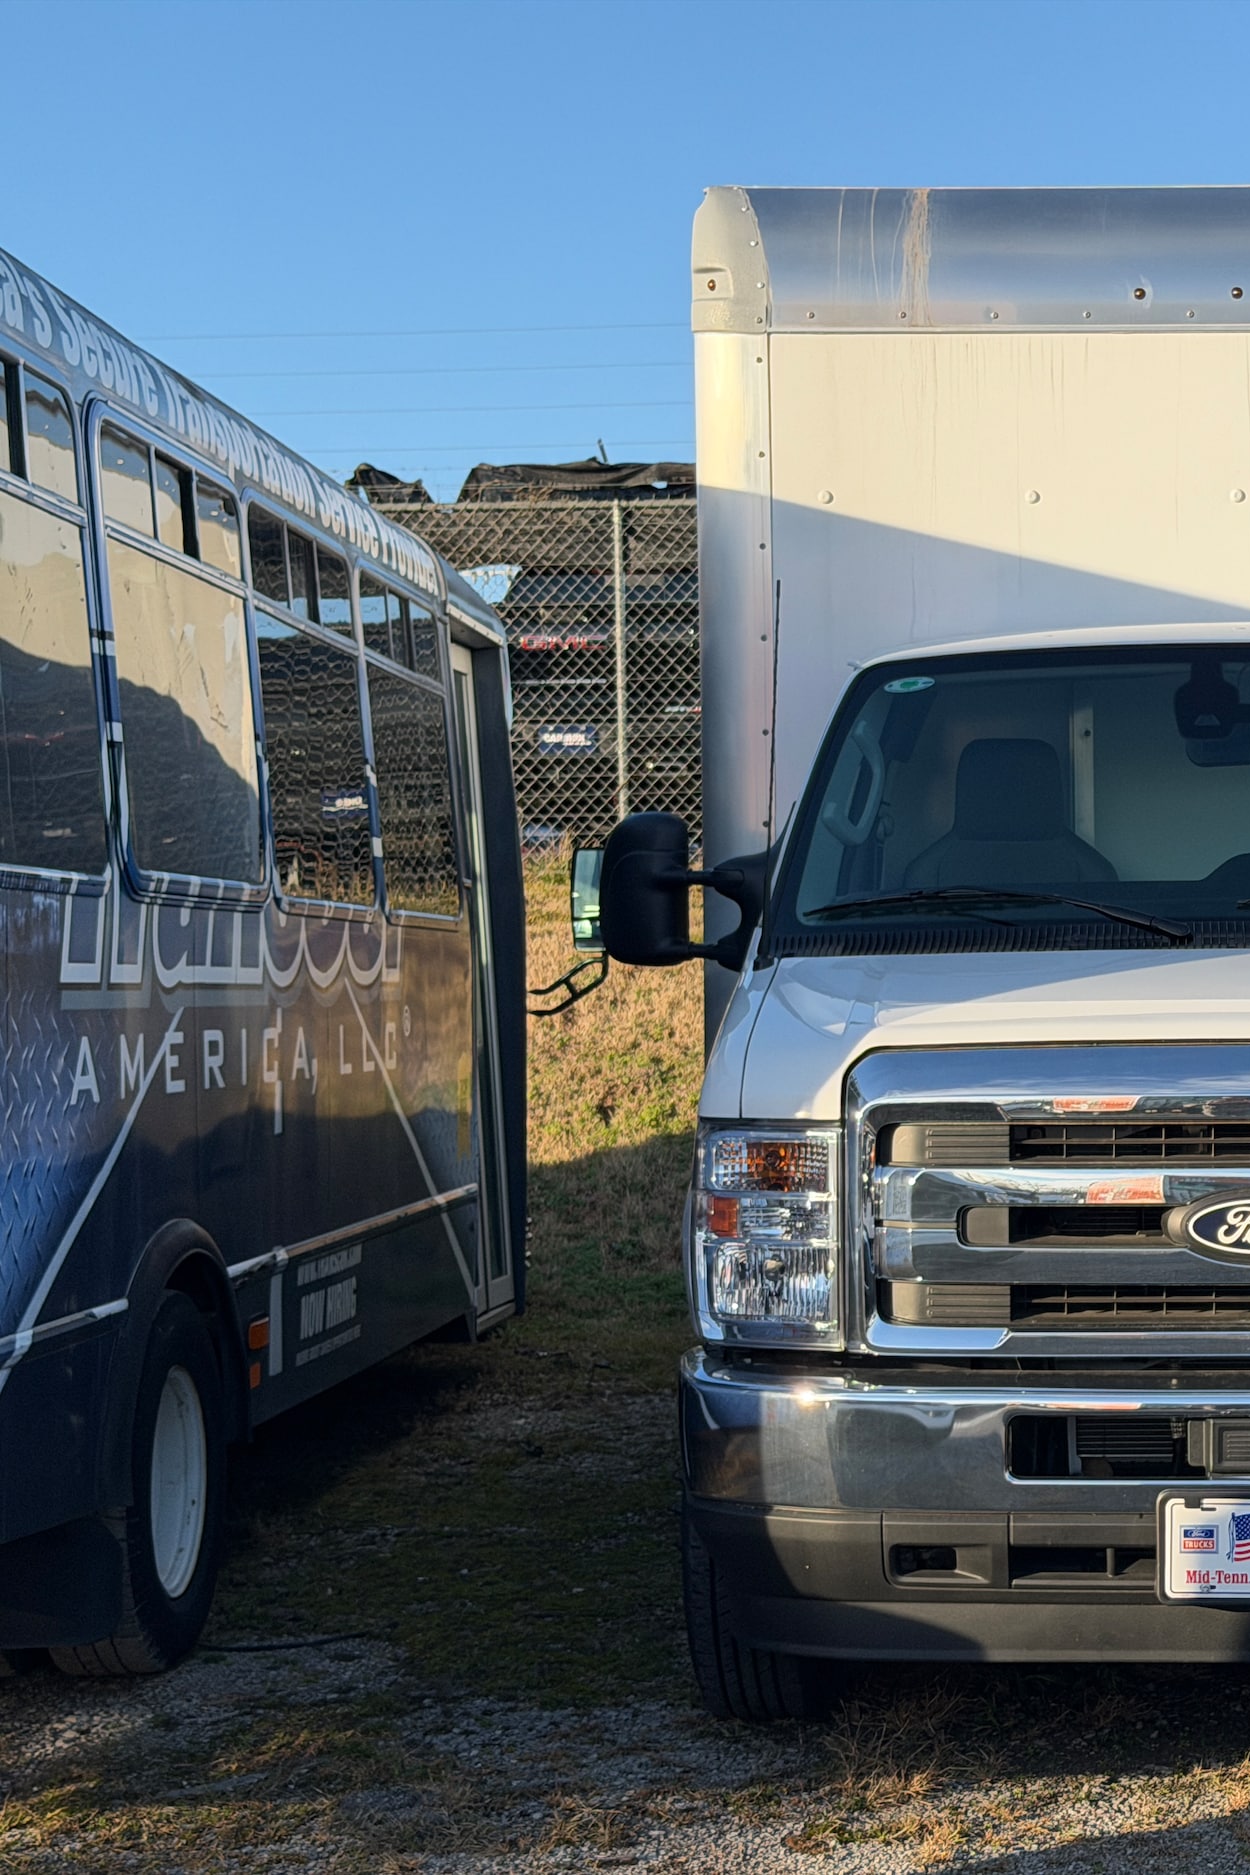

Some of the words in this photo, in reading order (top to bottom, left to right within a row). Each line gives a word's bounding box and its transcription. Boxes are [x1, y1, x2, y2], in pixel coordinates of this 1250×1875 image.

[40, 279, 159, 417] Secure
[144, 352, 316, 518] Transportation
[302, 462, 380, 559] Service
[520, 634, 608, 651] GMC
[69, 1026, 319, 1105] AMERICA,
[1184, 1541, 1214, 1549] TRUCKS
